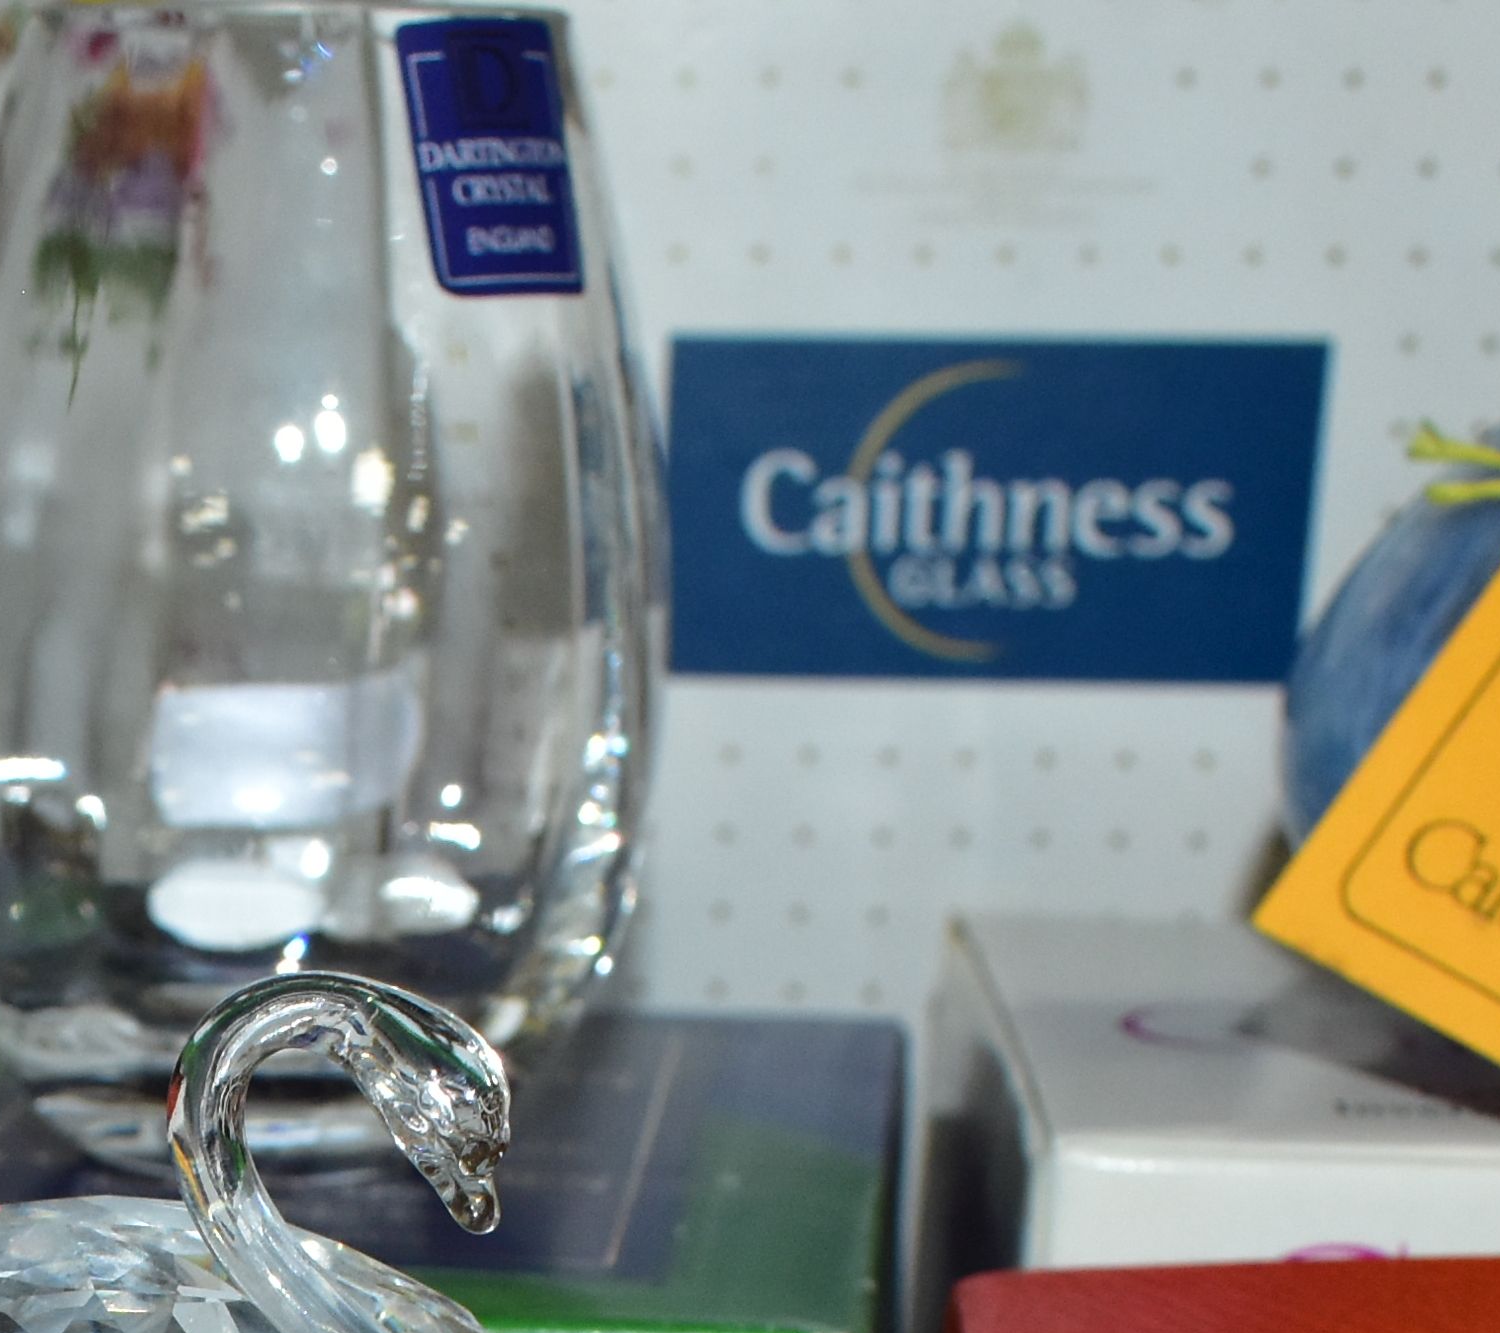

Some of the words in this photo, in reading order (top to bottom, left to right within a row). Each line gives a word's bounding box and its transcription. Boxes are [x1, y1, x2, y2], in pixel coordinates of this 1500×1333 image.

[451, 172, 551, 207] CRYSTAL
[464, 225, 556, 256] ENGLAND
[738, 447, 1236, 561] Caithness
[888, 555, 1077, 610] GLASS
